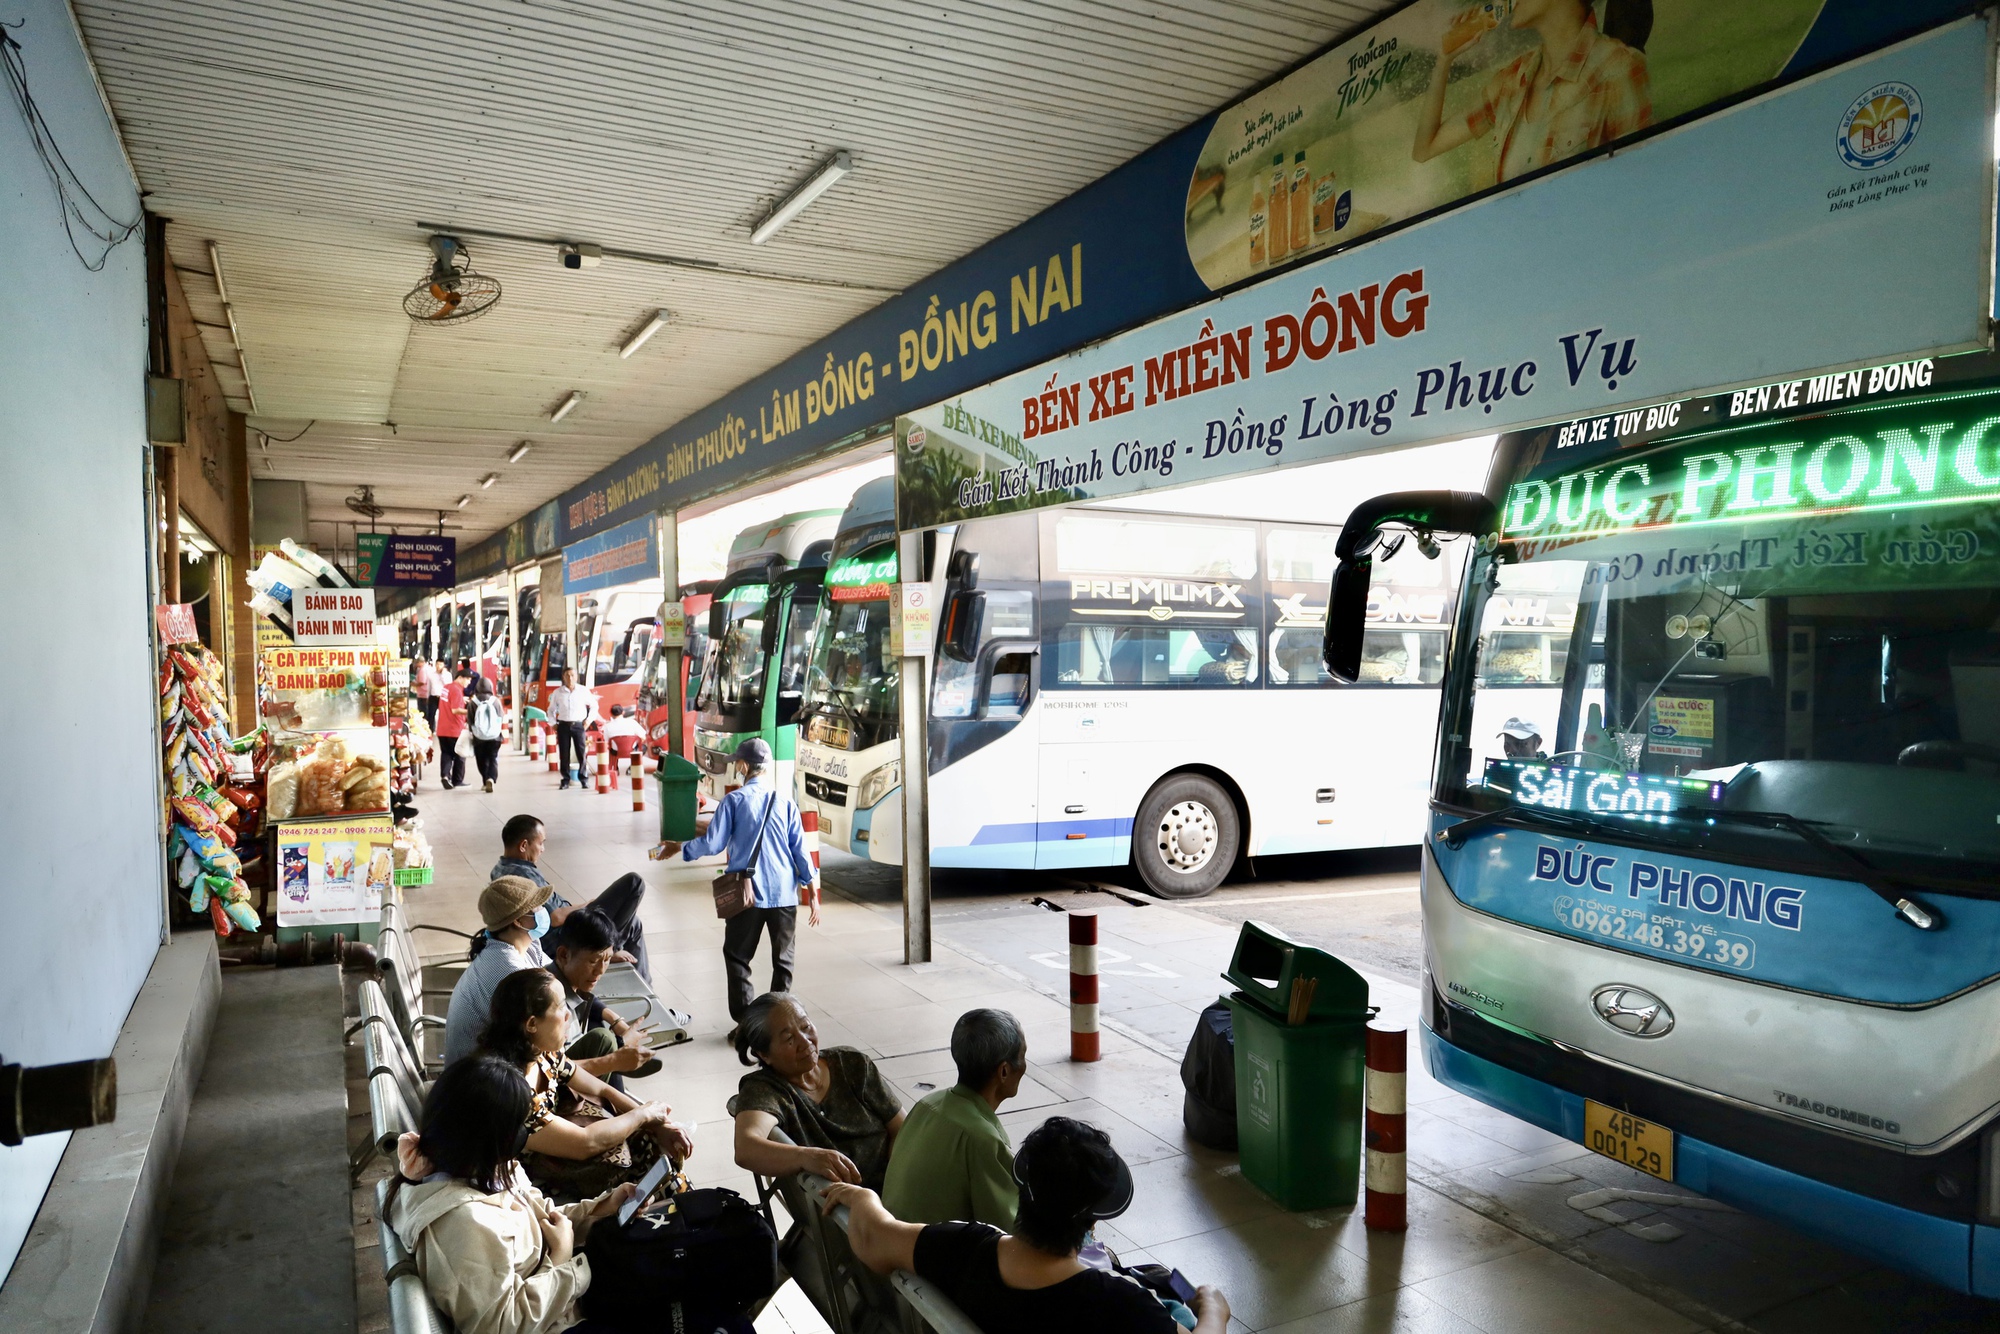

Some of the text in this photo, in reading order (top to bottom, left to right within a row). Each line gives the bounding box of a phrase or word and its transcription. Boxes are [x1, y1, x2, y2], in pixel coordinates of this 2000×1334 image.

[1348, 37, 1398, 75] Tropicana
[1336, 52, 1412, 120] Twister
[1227, 150, 1239, 165] cho
[1868, 170, 1900, 187] Thành
[1903, 163, 1930, 178] Công
[1857, 192, 1882, 206] Lòng
[1885, 183, 1911, 197] Phục
[1914, 178, 1928, 189] Vụ
[1022, 268, 1429, 440] BẾN XE MIỀN ĐÔNG
[607, 477, 626, 513] BÌNH
[627, 461, 660, 502] DƯƠNG
[667, 443, 695, 485] BÌNH
[697, 413, 747, 471] PHƯỚC
[760, 389, 801, 444] LÂM
[806, 352, 875, 424] ĐỒNG
[899, 294, 998, 383] ĐỒNG
[1011, 242, 1082, 334] NAI
[959, 470, 993, 507] Gắn
[998, 462, 1029, 500] Kết
[1035, 449, 1103, 493] Thành
[1112, 440, 1176, 476] Công
[1202, 407, 1288, 460] Đồng
[1298, 388, 1398, 441] Lòng
[1411, 360, 1537, 418] Phục
[1558, 328, 1637, 391] Vụ
[1588, 417, 1610, 442] XE
[1613, 410, 1645, 438] TUY
[1773, 382, 1803, 410] XE
[908, 432, 925, 445] SAMCO
[979, 419, 1000, 449] XE
[358, 563, 371, 581] 2
[305, 592, 338, 610] BÁNH
[340, 595, 363, 610] BAO
[297, 616, 374, 638] BÁNH MÌ THỊT
[277, 650, 295, 668] CÀ
[300, 650, 324, 667] PHÊ
[329, 651, 355, 666] PHA
[277, 672, 314, 689] BÁNH
[318, 673, 345, 689] BAO
[1516, 765, 1673, 824] Sài Gòn
[279, 827, 300, 836] 0946
[303, 827, 319, 835] 724
[322, 827, 337, 835] 247
[345, 826, 366, 834] 0906
[1535, 843, 1806, 932] ĐỨC PHONG
[1571, 906, 1750, 968] 0962.48.39.39
[1773, 1089, 1900, 1134] TRACOMECO
[1608, 1112, 1646, 1142] 48F
[1593, 1129, 1662, 1175] 001.29
